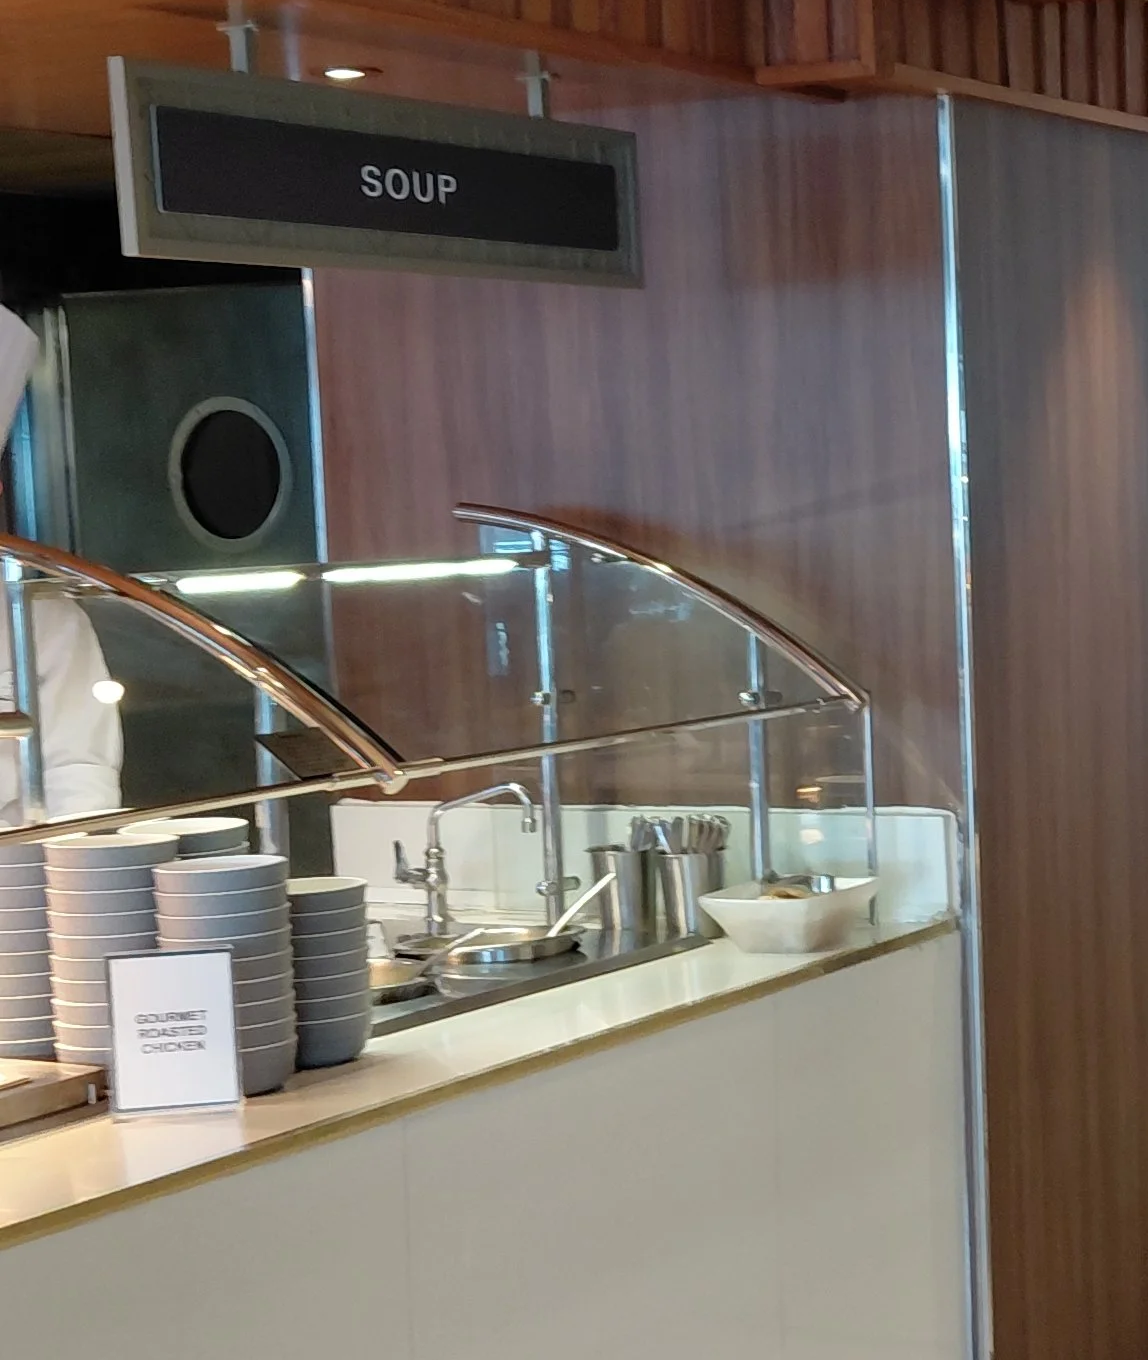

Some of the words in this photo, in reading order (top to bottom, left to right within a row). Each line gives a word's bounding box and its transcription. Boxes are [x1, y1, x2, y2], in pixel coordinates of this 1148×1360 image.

[360, 164, 458, 205] SOUP
[133, 1009, 208, 1025] GOURMET
[136, 1025, 208, 1039] ROASTED
[140, 1040, 207, 1055] CHICKEN
